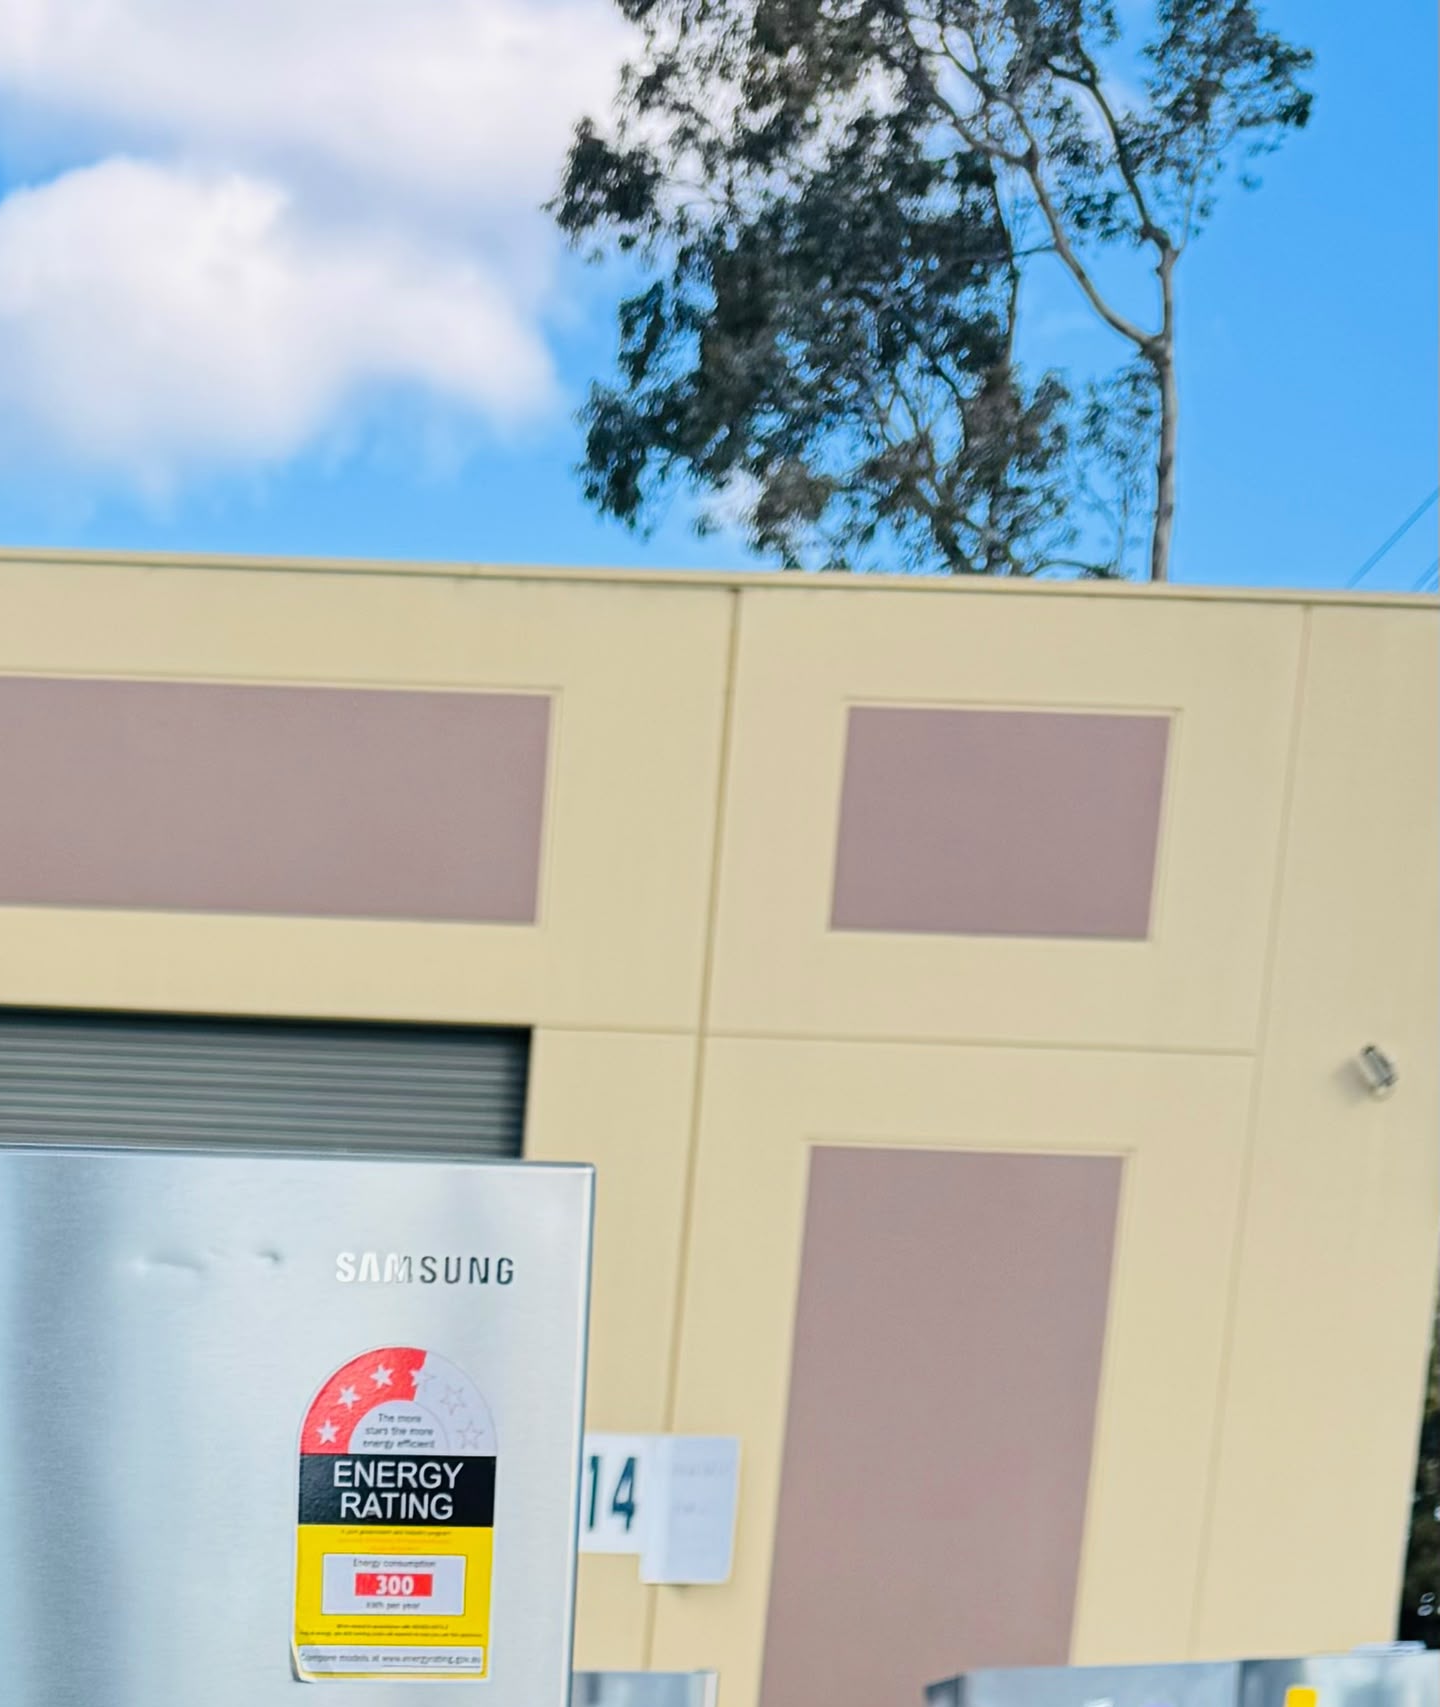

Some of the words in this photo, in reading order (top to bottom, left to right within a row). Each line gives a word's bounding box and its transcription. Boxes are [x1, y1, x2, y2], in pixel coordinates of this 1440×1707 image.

[335, 1251, 515, 1286] SAMSUNG
[378, 1412, 395, 1423] The
[333, 1460, 464, 1489] ENERGY
[340, 1492, 453, 1520] RATING
[587, 1455, 636, 1533] 14
[353, 1558, 381, 1569] Energy
[383, 1559, 436, 1569] consumption
[375, 1575, 414, 1596] 300
